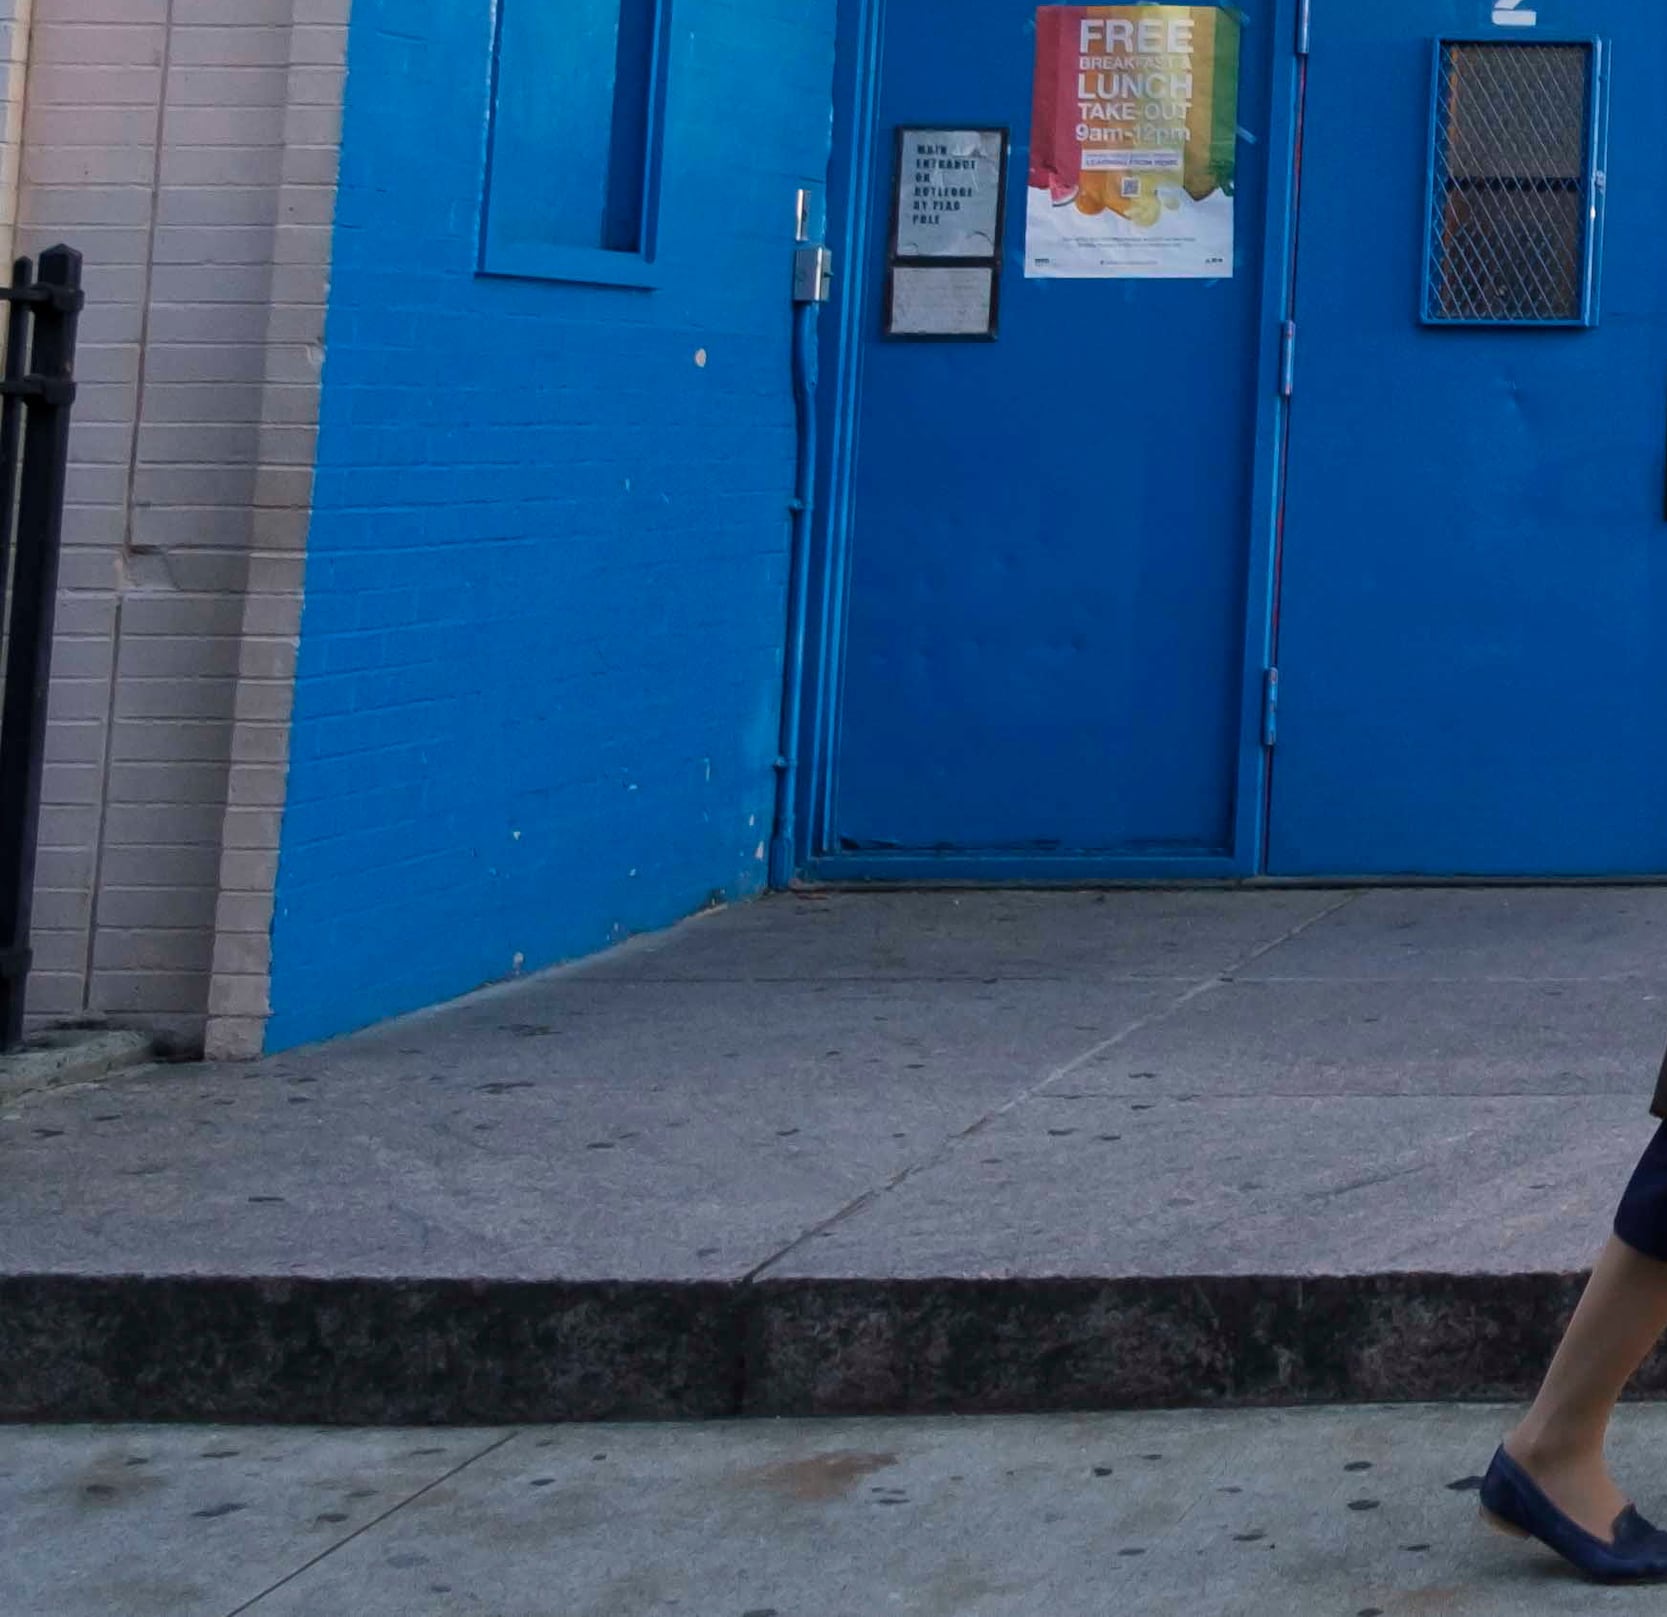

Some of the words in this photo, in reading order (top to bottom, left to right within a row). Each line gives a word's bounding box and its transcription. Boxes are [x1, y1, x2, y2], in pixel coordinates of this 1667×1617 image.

[1080, 19, 1195, 54] FREE
[1080, 56, 1175, 70] BREAKFAST
[1078, 73, 1193, 99] LUNCH
[1078, 102, 1136, 121] TAKE
[1144, 102, 1192, 120] OUT
[1076, 123, 1191, 145] 9am-12pm
